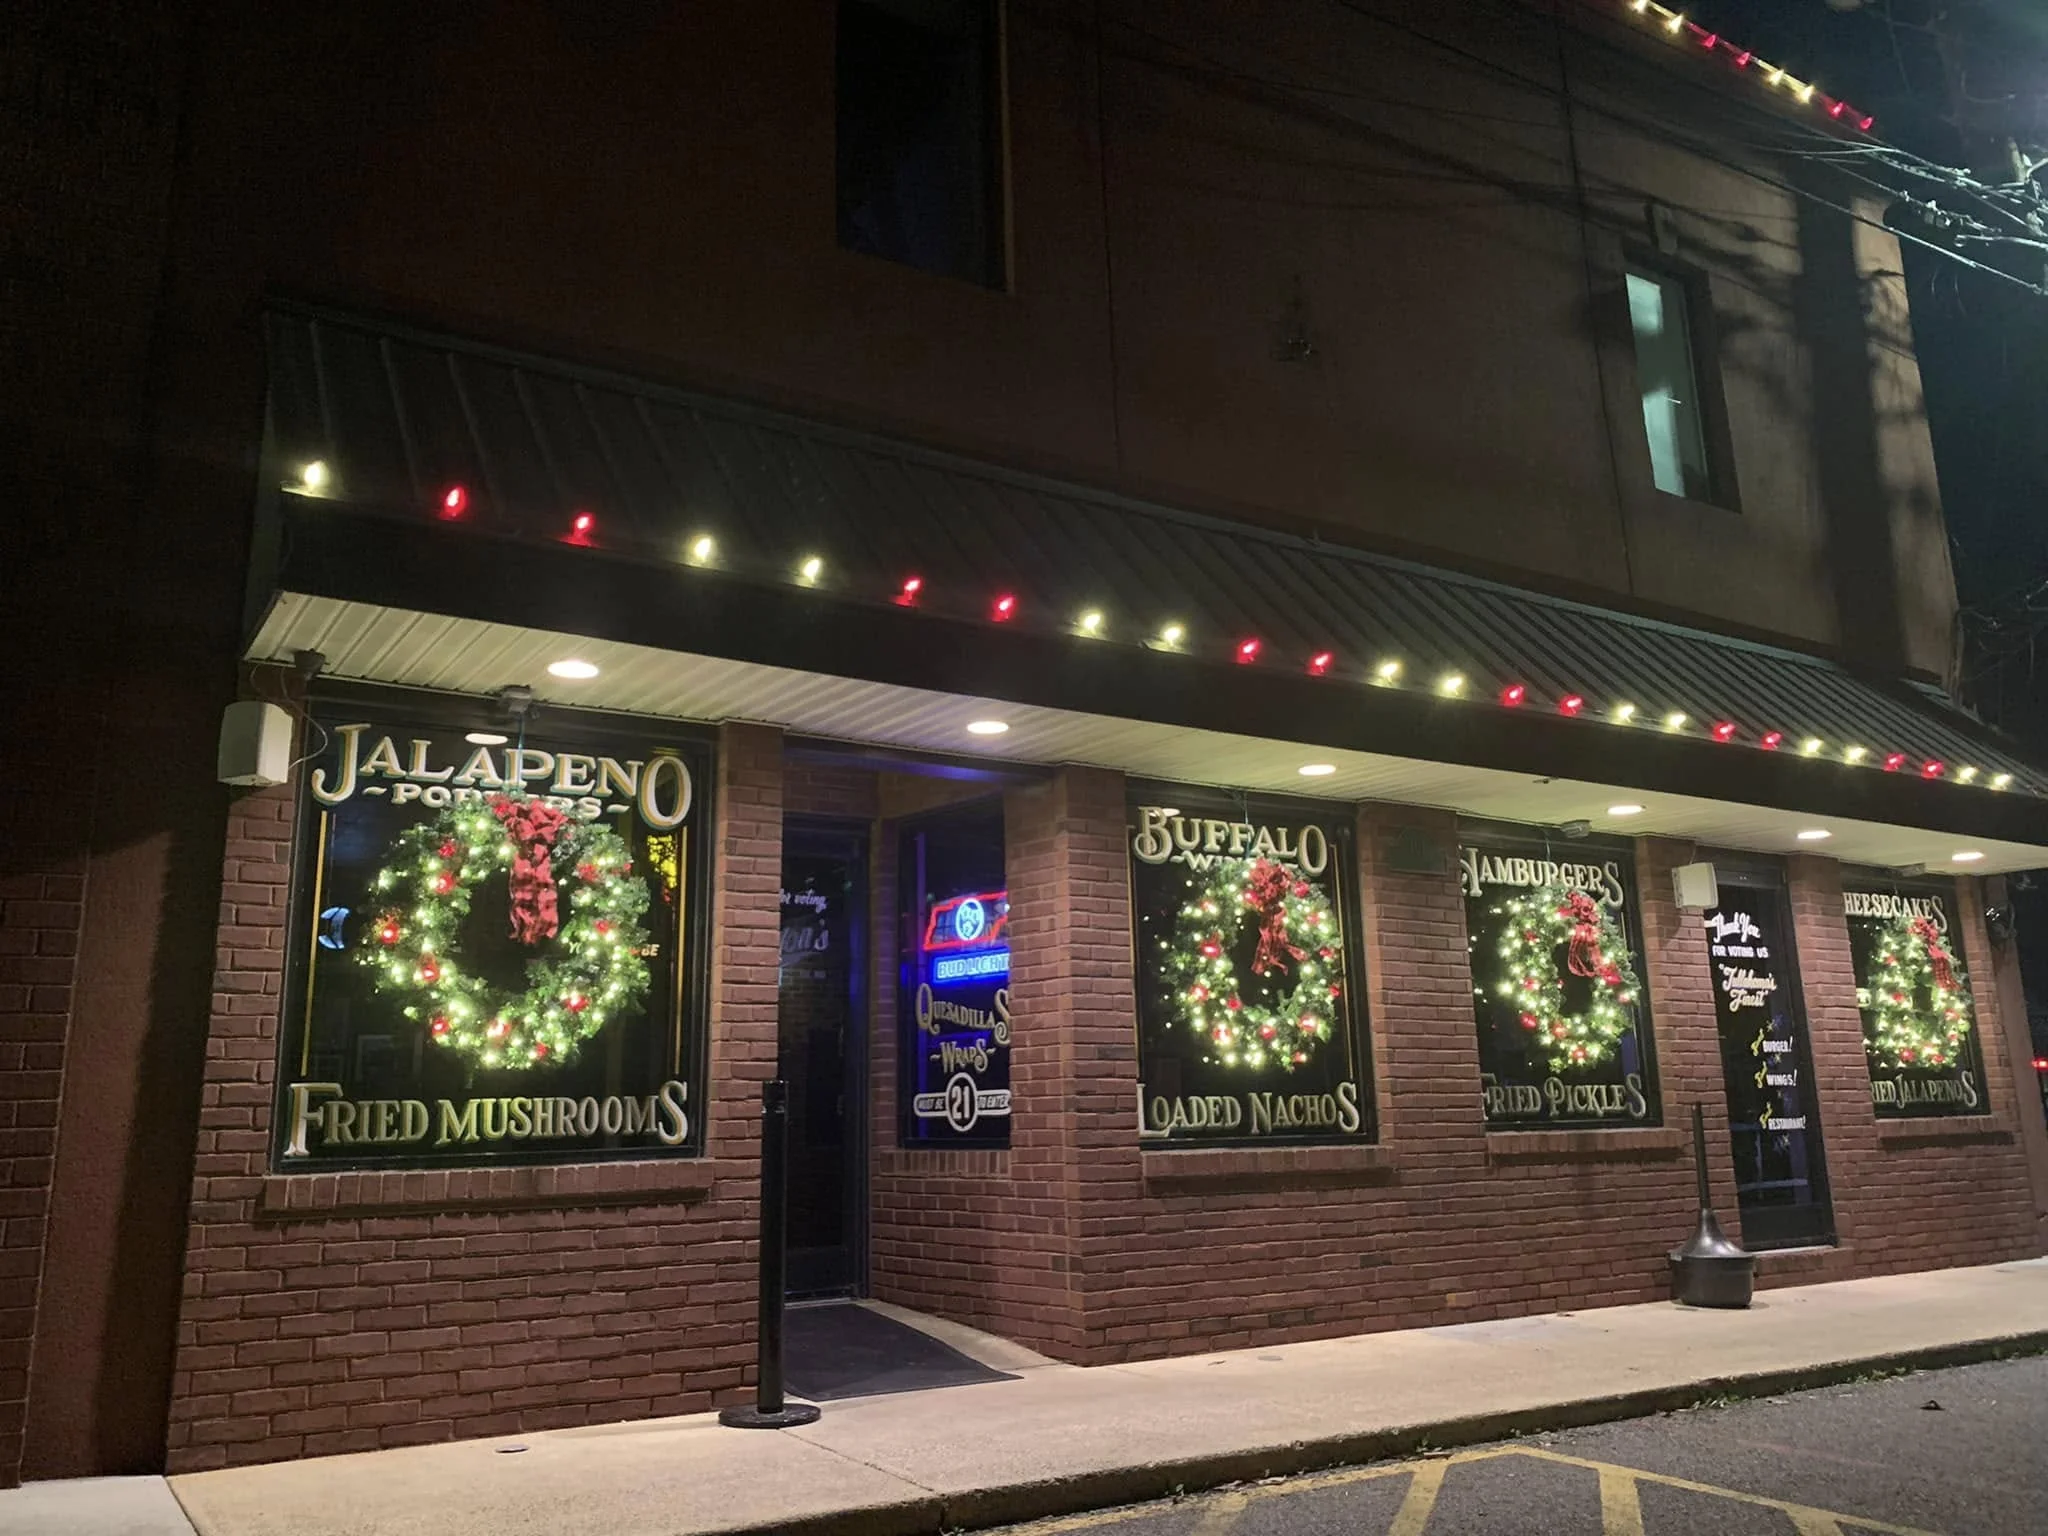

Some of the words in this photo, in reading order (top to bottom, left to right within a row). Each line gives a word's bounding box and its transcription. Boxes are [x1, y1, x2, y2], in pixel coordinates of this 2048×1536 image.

[312, 723, 692, 828] JALAPENO
[1134, 806, 1327, 876] BUFFALO
[1739, 912, 1760, 942] You
[1842, 892, 1948, 933] HEESECAKES
[937, 959, 965, 978] BUD
[967, 953, 1010, 975] LIGHT
[1712, 945, 1727, 957] FOR
[1756, 947, 1769, 958] US
[916, 983, 1010, 1045] QUESADILLAS
[1544, 1073, 1646, 1118] PICKLES
[1766, 1069, 1797, 1087] WINGS!
[1895, 1070, 1977, 1108] JALAPENOS
[288, 1082, 429, 1157] FRIED
[434, 1080, 688, 1146] MUSHROOMS
[952, 1085, 970, 1119] 21
[1136, 1083, 1241, 1138] LOADED
[1251, 1082, 1360, 1136] NACHOS
